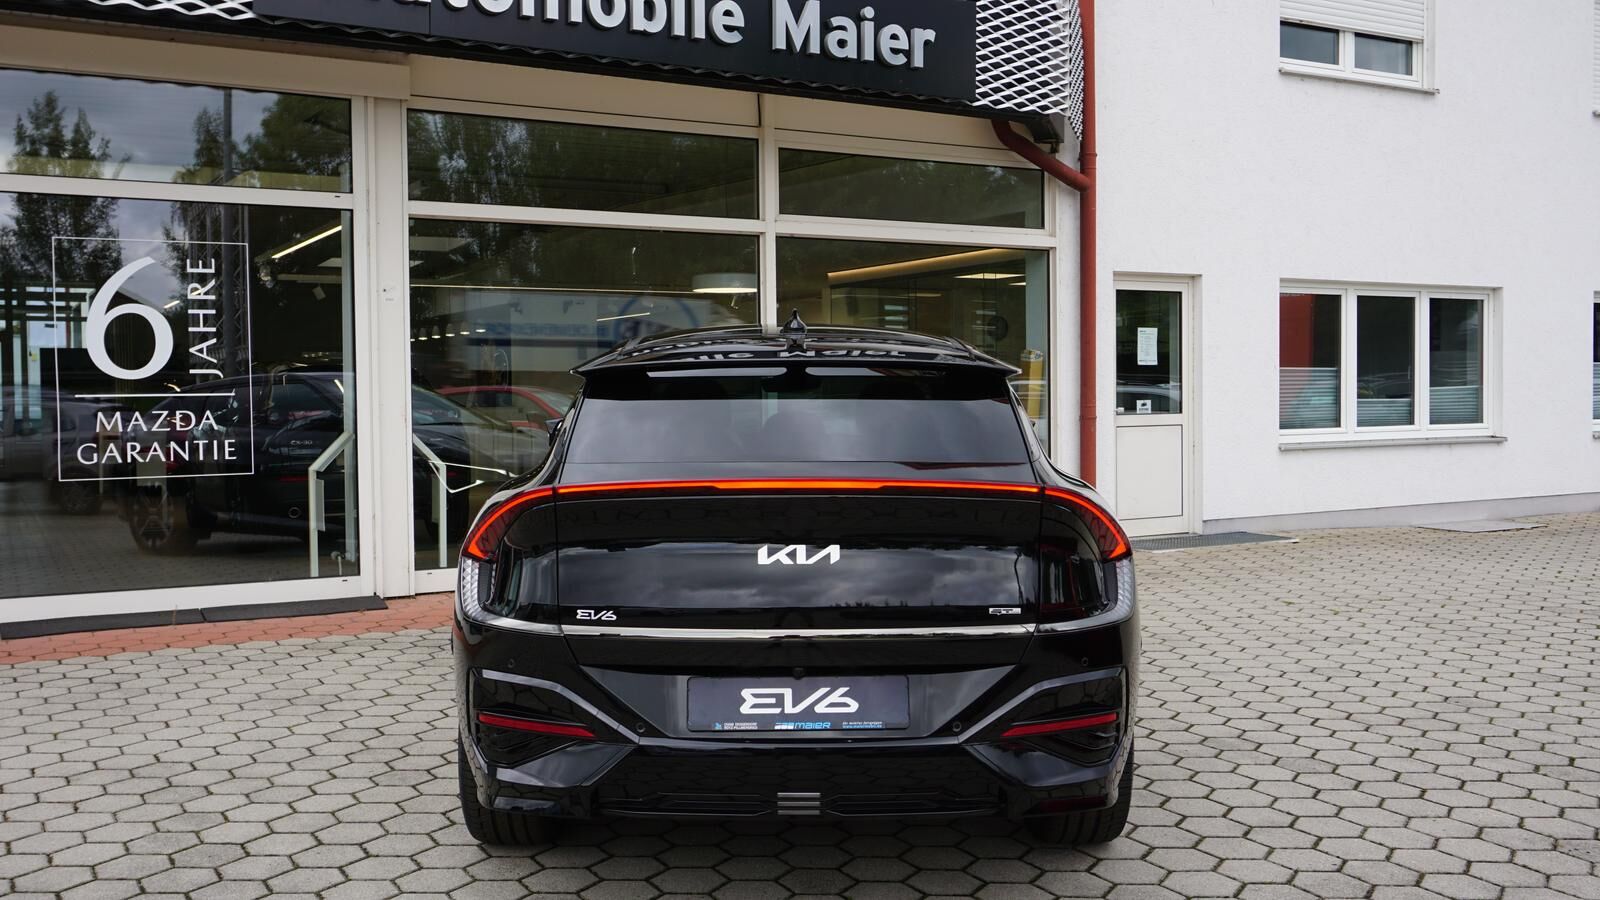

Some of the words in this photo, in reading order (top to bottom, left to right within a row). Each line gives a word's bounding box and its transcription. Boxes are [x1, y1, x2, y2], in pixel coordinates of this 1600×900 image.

[772, 0, 937, 68] Maier
[86, 256, 174, 380] 6
[186, 258, 224, 379] JAHRE
[95, 410, 219, 433] MAZDA
[76, 439, 238, 465] GARANTIE
[575, 609, 617, 621] EV6
[739, 687, 859, 714] EV6
